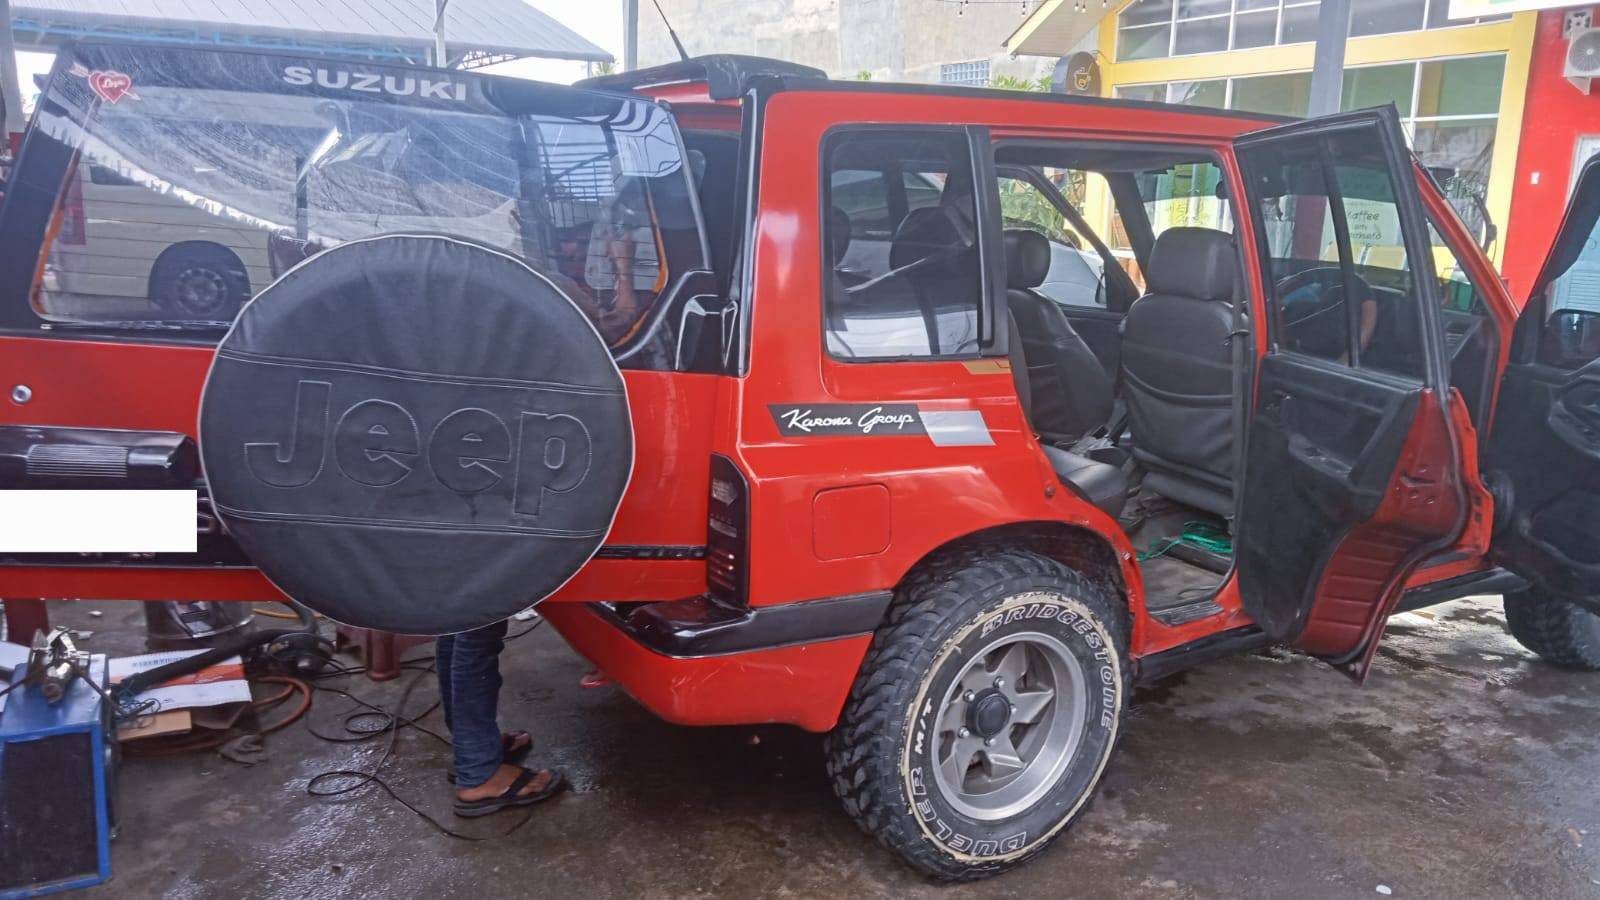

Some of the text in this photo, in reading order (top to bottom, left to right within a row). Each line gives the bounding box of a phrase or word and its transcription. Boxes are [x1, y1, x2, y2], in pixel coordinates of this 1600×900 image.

[282, 66, 467, 101] SUZUKI
[244, 379, 592, 517] Jeep
[780, 406, 915, 433] Karona Group
[980, 604, 1117, 731] BRIDGESTONE
[910, 697, 1027, 858] DUELER M/T
